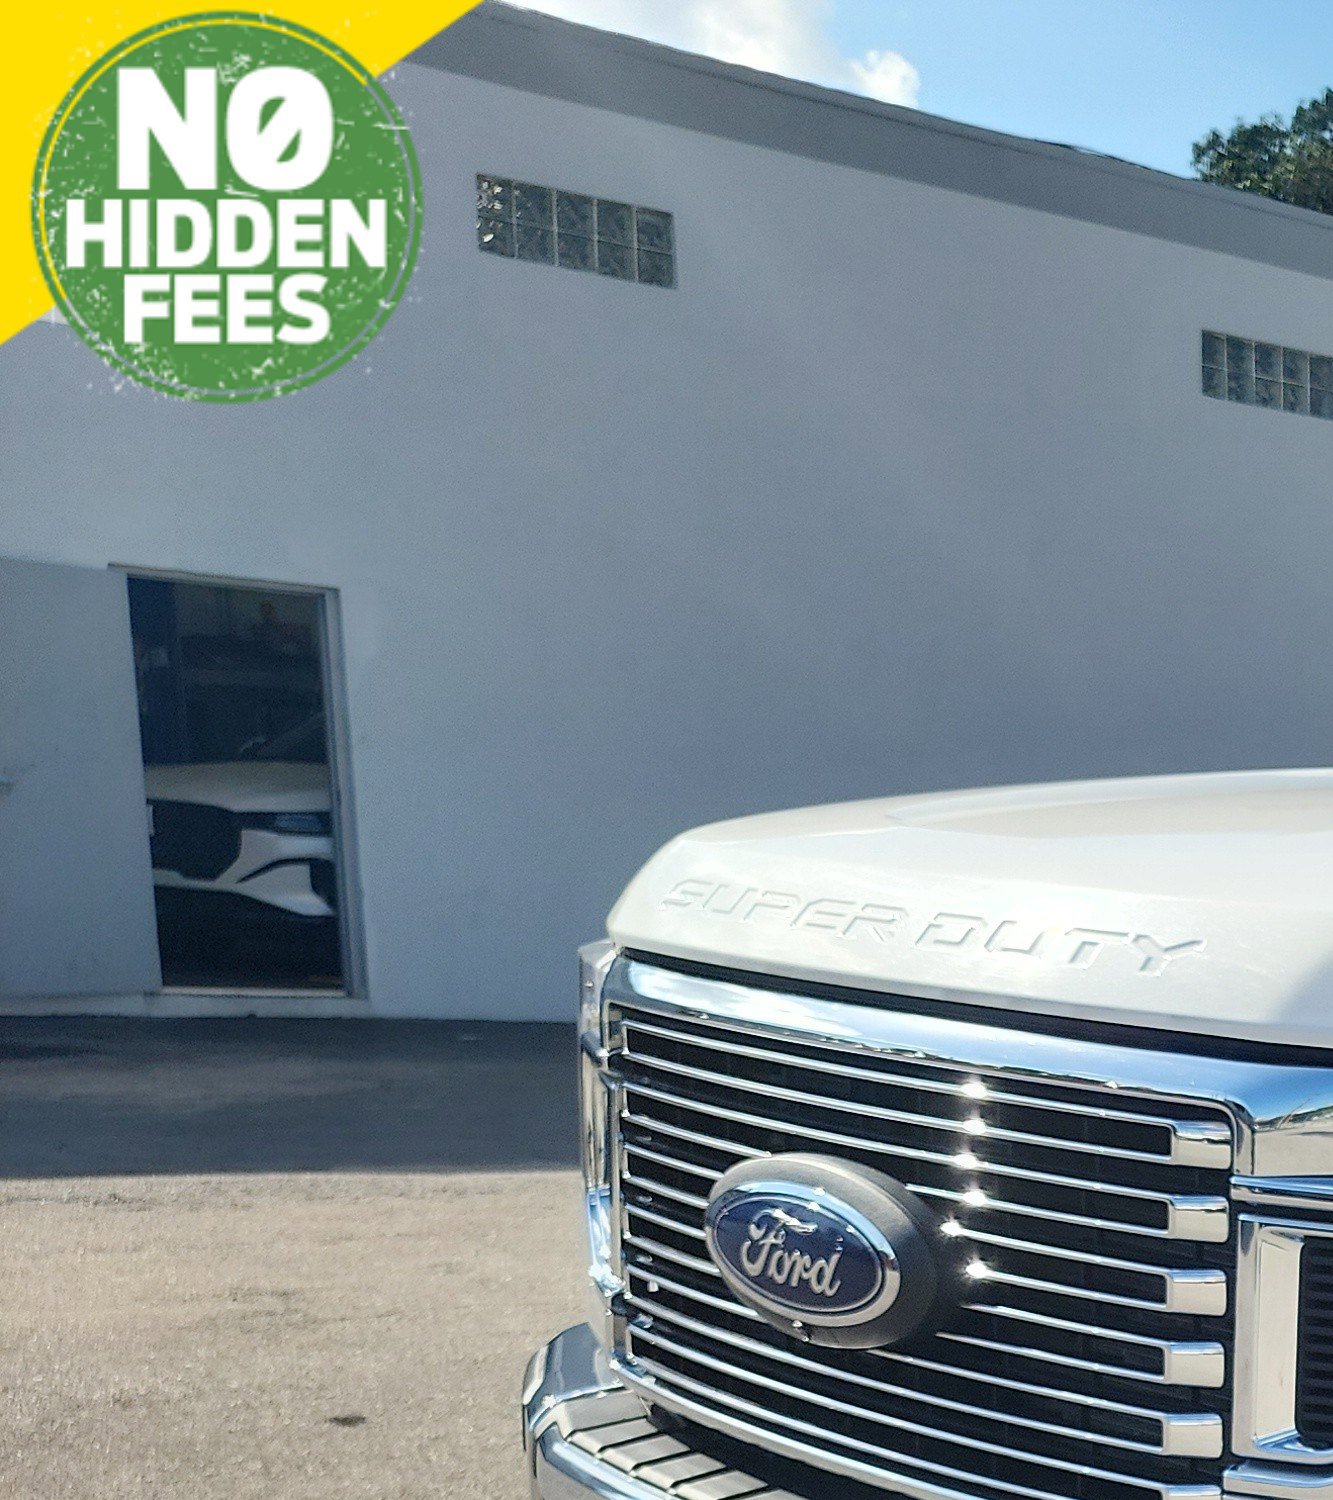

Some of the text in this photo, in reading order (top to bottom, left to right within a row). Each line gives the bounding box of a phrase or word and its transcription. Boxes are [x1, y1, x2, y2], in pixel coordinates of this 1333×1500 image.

[658, 878, 1207, 977] SUPER DUTY
[740, 1206, 843, 1299] Ford
